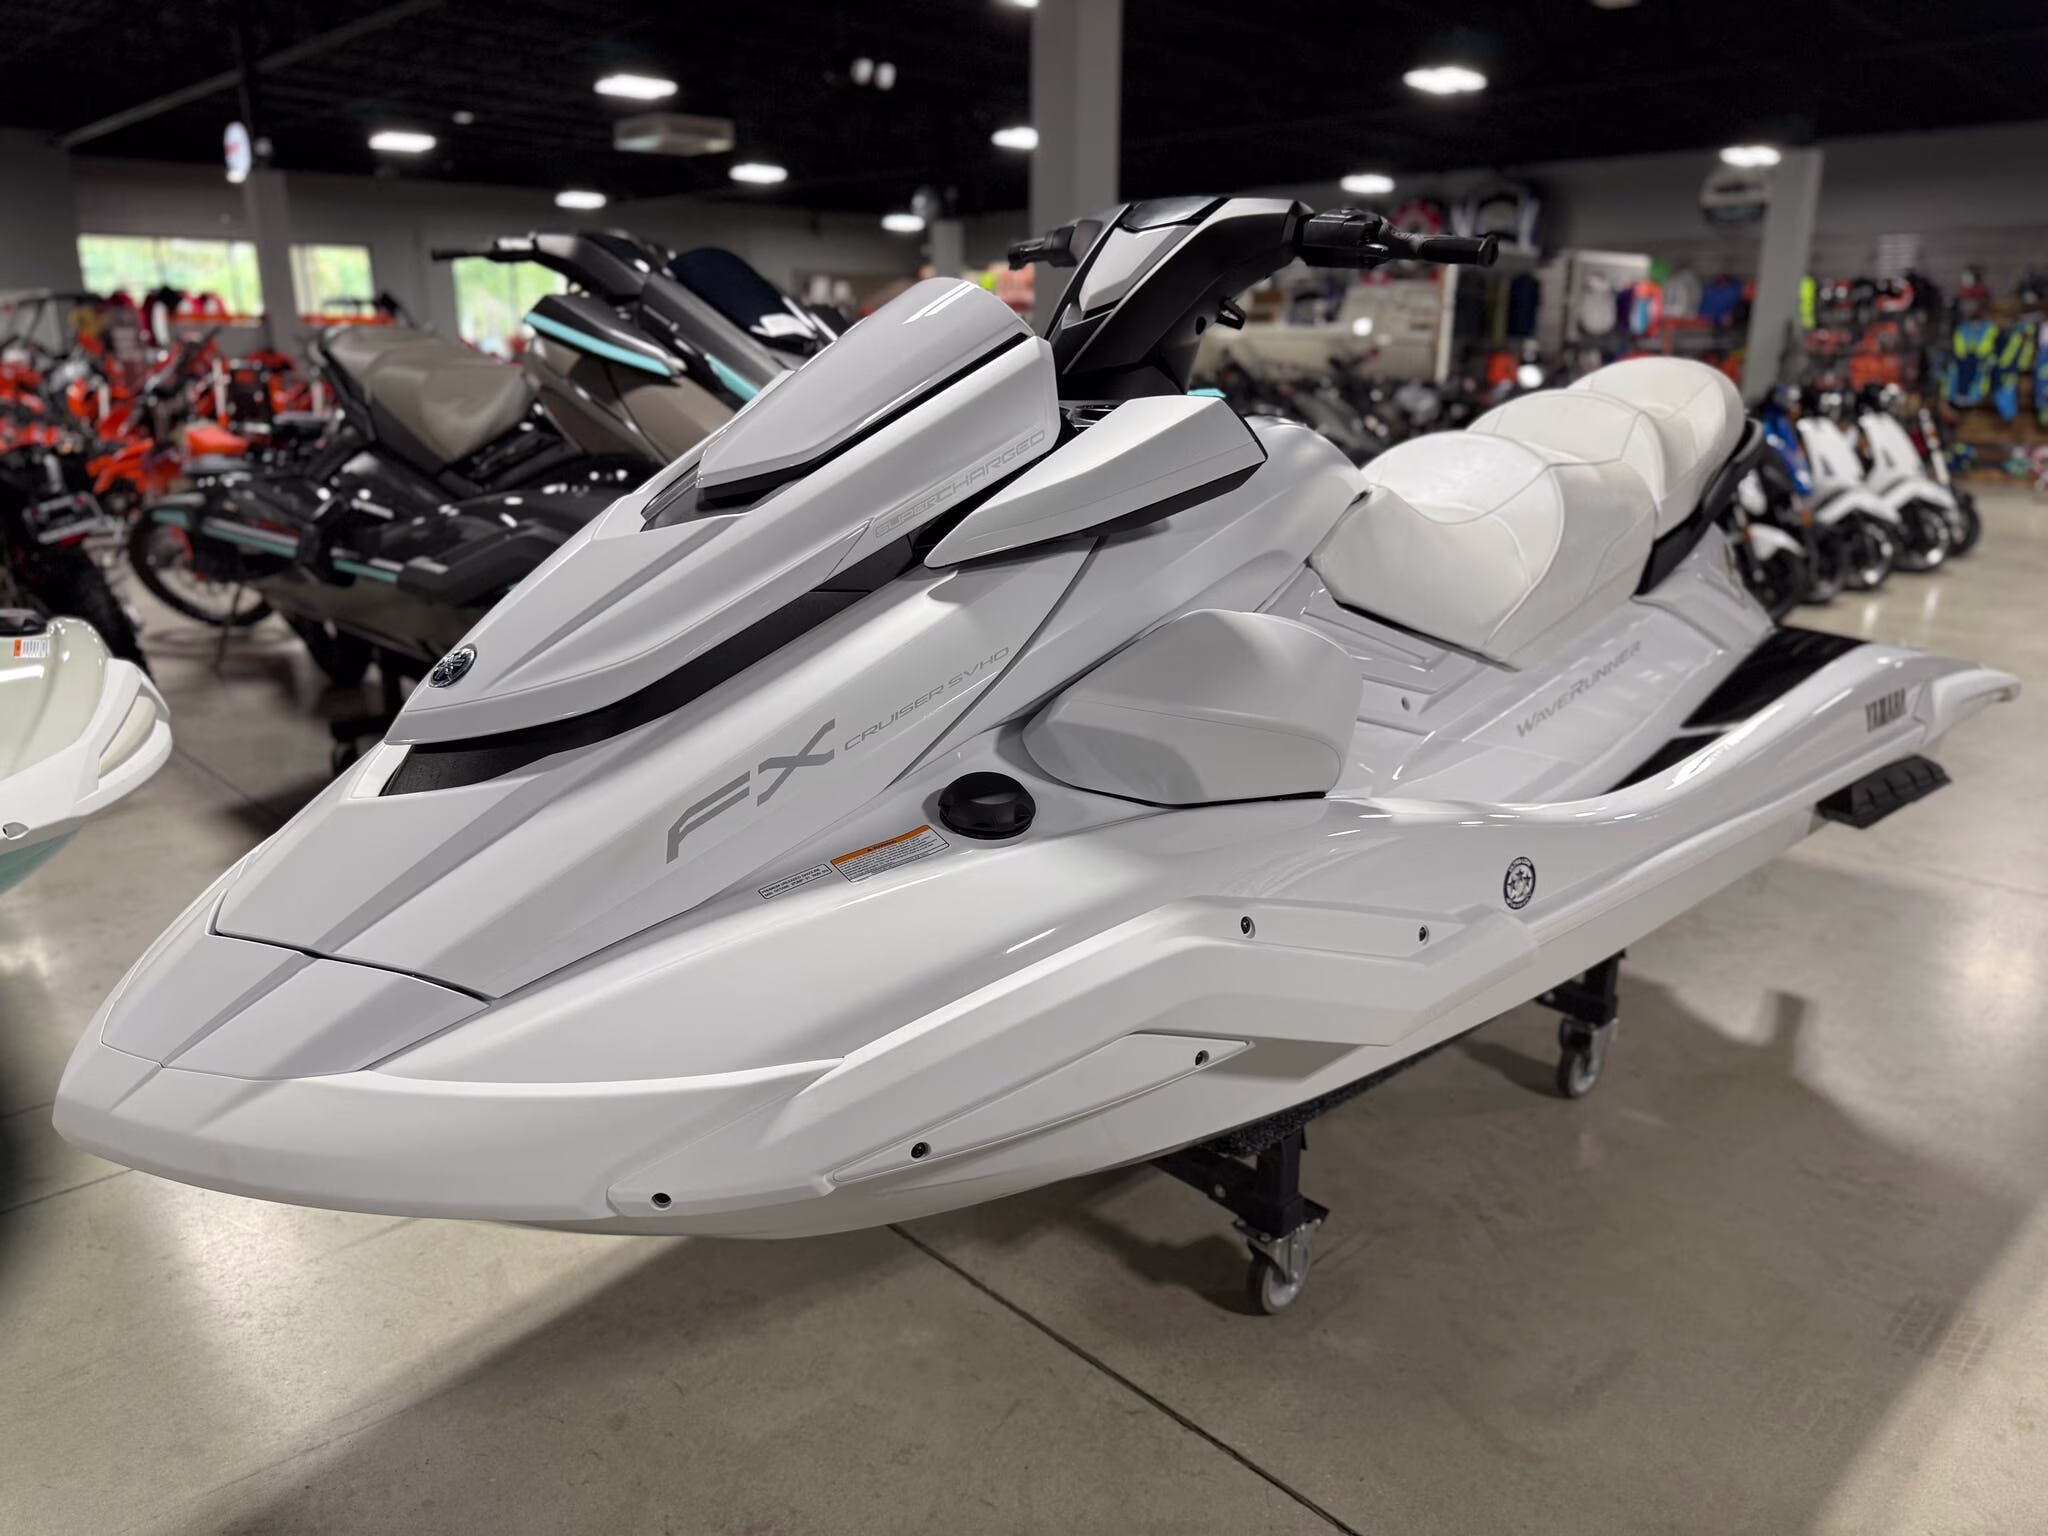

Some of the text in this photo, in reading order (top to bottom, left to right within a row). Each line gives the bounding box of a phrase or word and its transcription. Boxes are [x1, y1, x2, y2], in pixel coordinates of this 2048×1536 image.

[666, 718, 836, 864] FX
[844, 684, 944, 751] CRUISER
[948, 646, 1010, 689] SVHO
